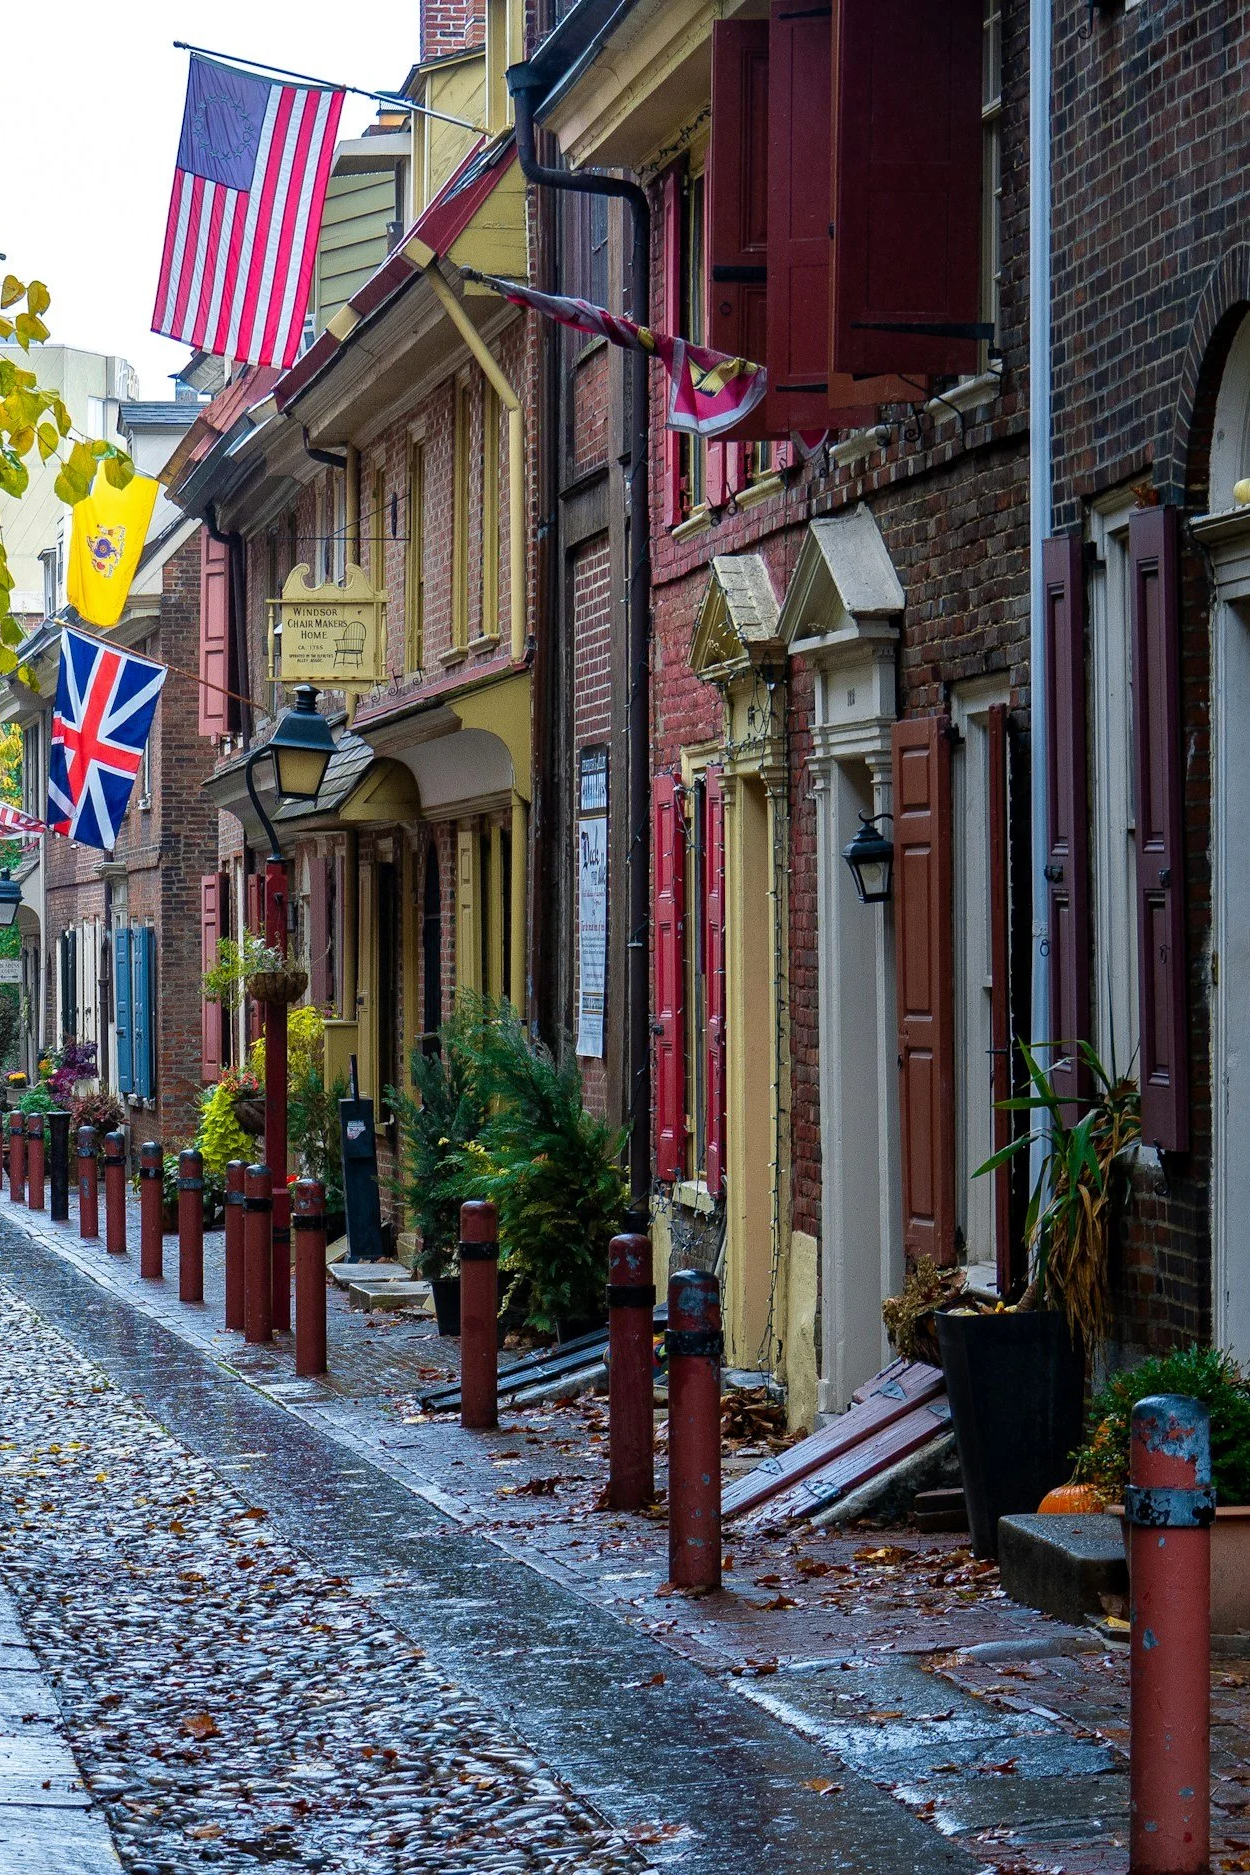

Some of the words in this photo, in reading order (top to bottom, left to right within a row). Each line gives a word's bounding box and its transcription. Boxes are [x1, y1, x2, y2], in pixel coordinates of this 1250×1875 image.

[293, 607, 337, 616] WINDSOR
[287, 619, 313, 628] CHAIR
[301, 630, 327, 639] HOME
